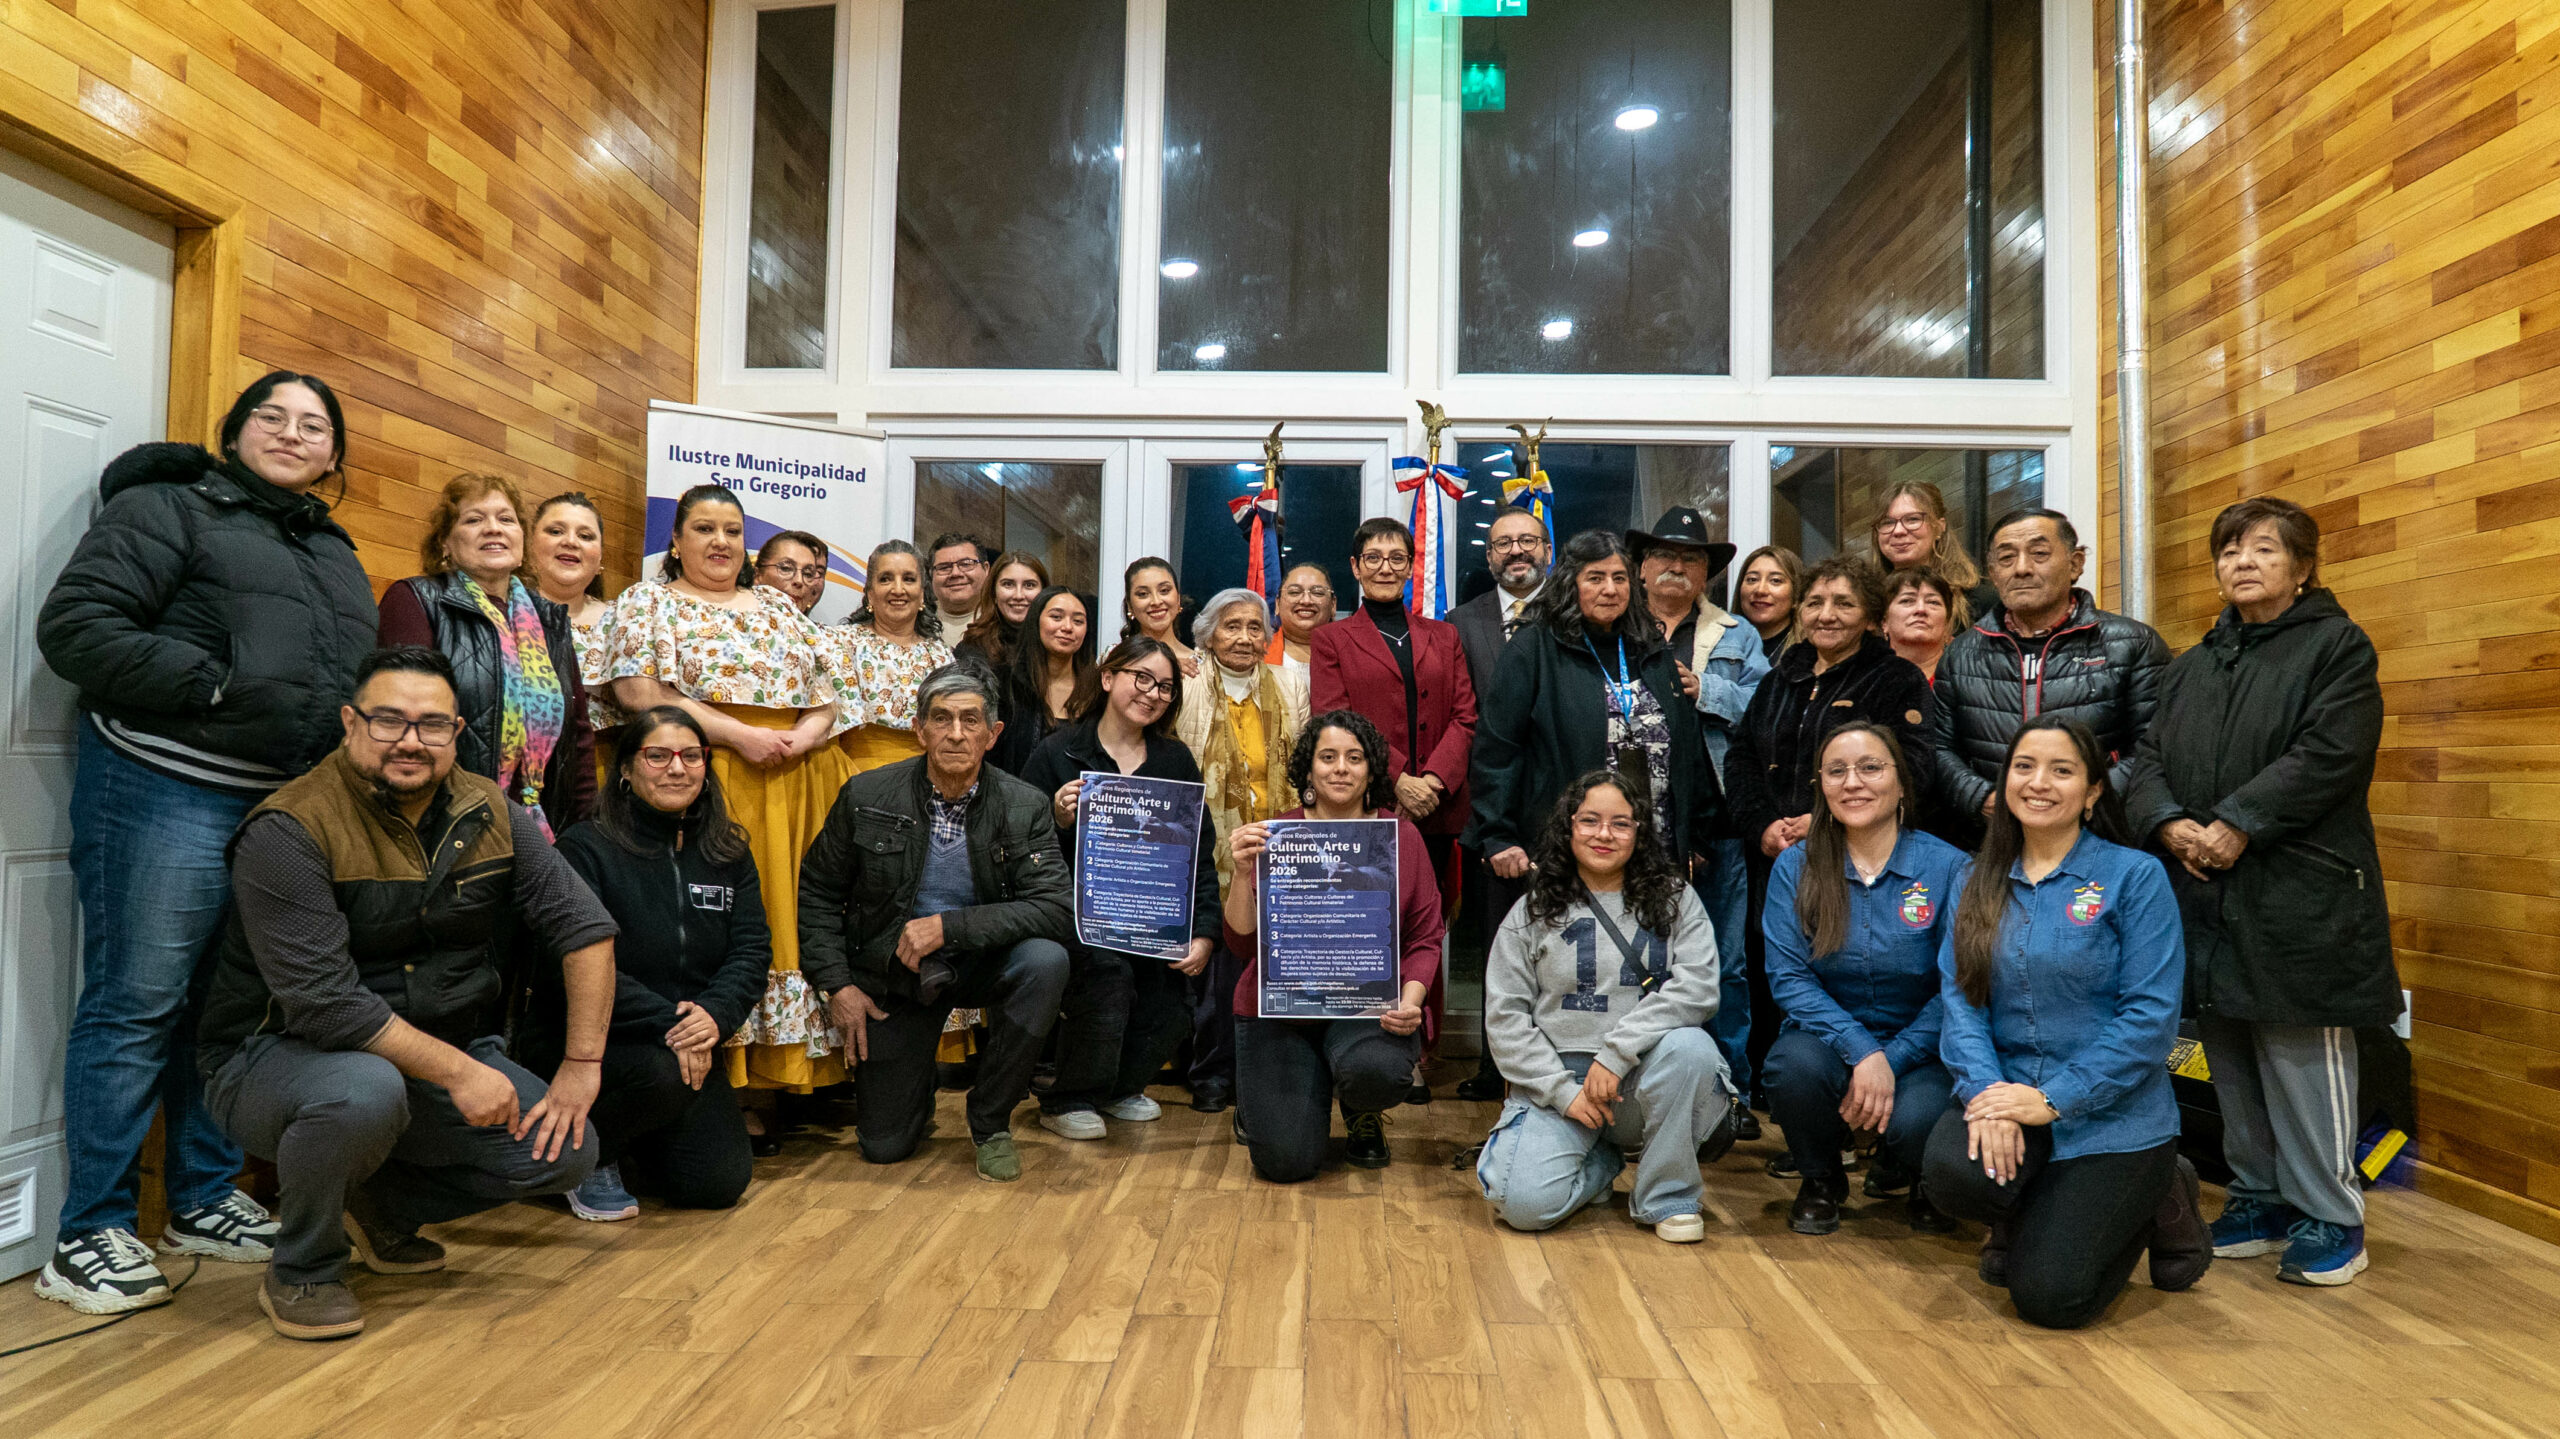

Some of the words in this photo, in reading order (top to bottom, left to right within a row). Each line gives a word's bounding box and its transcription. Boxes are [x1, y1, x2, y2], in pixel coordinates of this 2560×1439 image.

[668, 445, 730, 467] Ilustre
[735, 453, 866, 483] Municipalidad
[710, 472, 743, 491] San
[749, 476, 827, 499] Gregorio
[1114, 786, 1144, 794] Regionales
[1089, 791, 1136, 806] Cultura,
[1138, 796, 1161, 808] Arte
[1163, 800, 1171, 811] y
[1089, 802, 1152, 817] Patrimonio
[1088, 814, 1113, 824] 2026
[1087, 840, 1092, 848] 1
[1269, 842, 1320, 853] Cultura,
[1323, 841, 1350, 851] Arte
[1352, 842, 1361, 853] y
[1086, 856, 1093, 865] 2
[1269, 853, 1341, 864] Patrimonio
[1269, 866, 1298, 876] 2026
[1086, 872, 1093, 881] 3
[1085, 889, 1093, 897] 4
[1270, 895, 1276, 904] 1
[1271, 913, 1278, 923] 2
[1271, 931, 1279, 940] 3
[1271, 949, 1280, 958] 4
[1560, 917, 1674, 1012] 14
